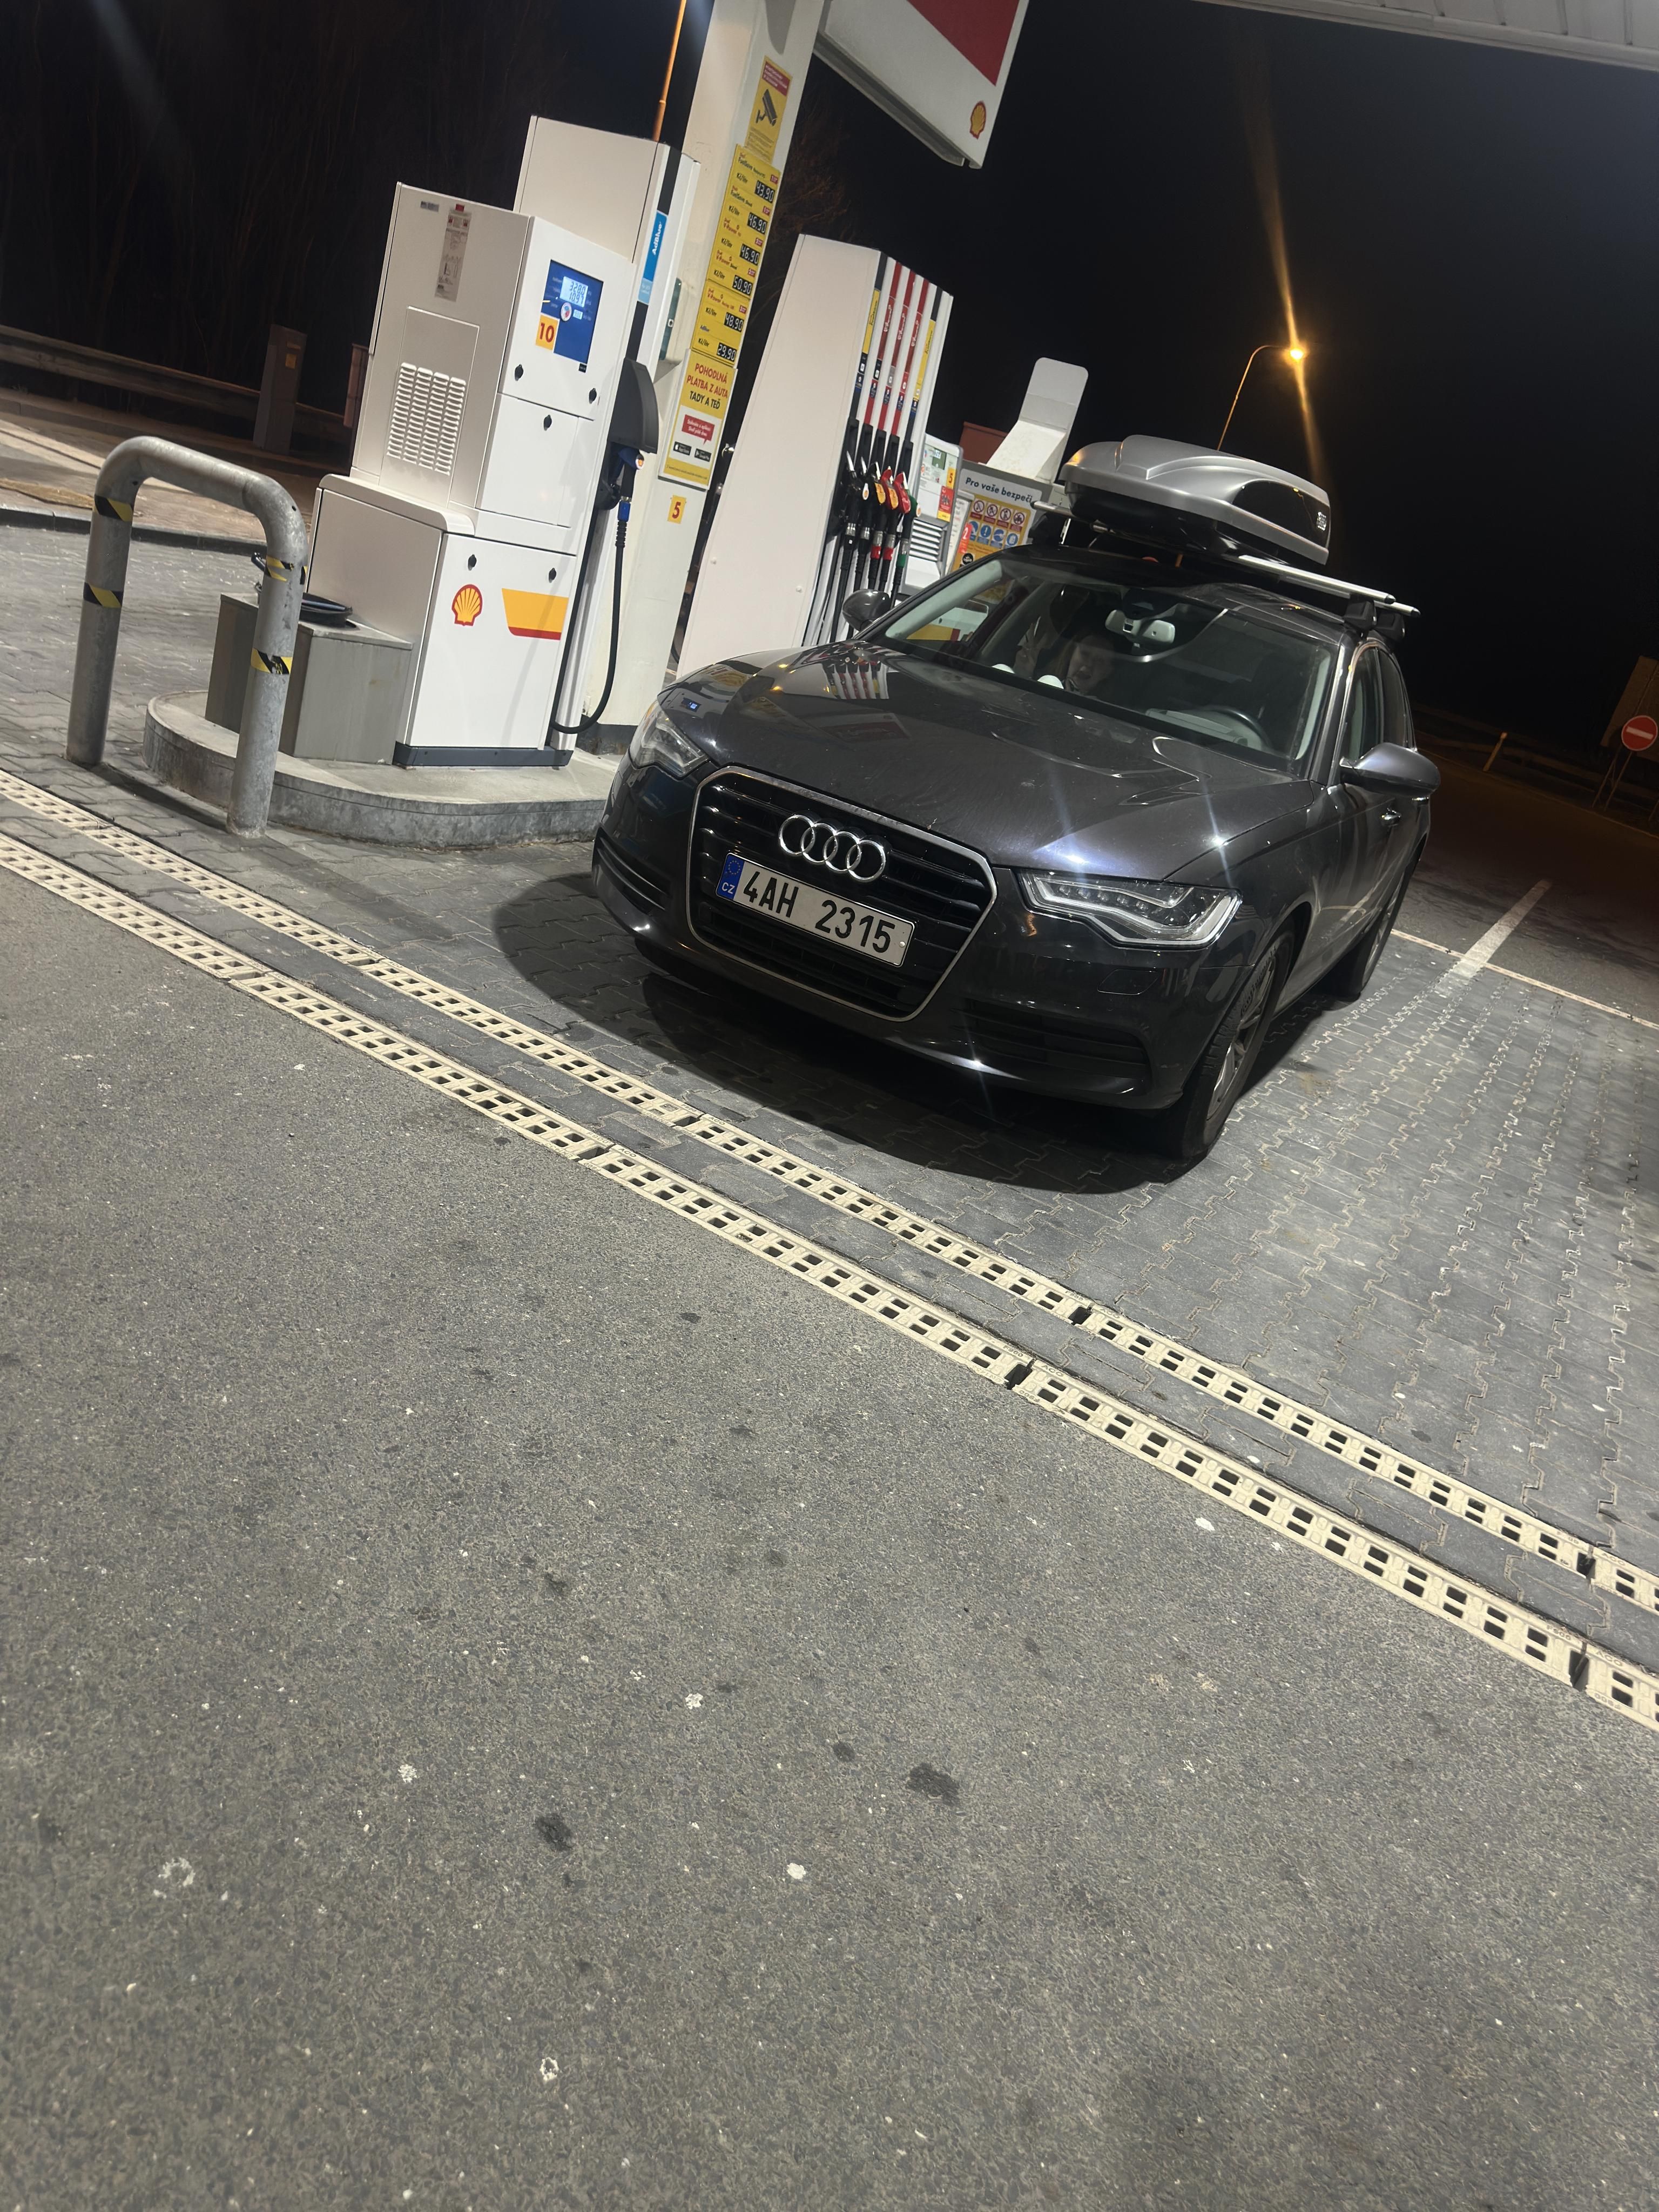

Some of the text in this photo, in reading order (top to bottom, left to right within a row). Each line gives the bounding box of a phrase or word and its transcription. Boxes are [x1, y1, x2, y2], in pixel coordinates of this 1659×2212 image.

[539, 322, 554, 343] 10
[695, 363, 728, 384] POHODLNÁ
[687, 375, 728, 399] PLATBA Z AUTA
[690, 390, 705, 403] TADY
[705, 397, 709, 406] A
[948, 473, 953, 483] 5
[966, 477, 979, 487] Pro
[981, 484, 999, 493] vaše
[672, 501, 681, 519] 5
[721, 881, 735, 895] CZ
[743, 871, 895, 953] 4AH 2315
